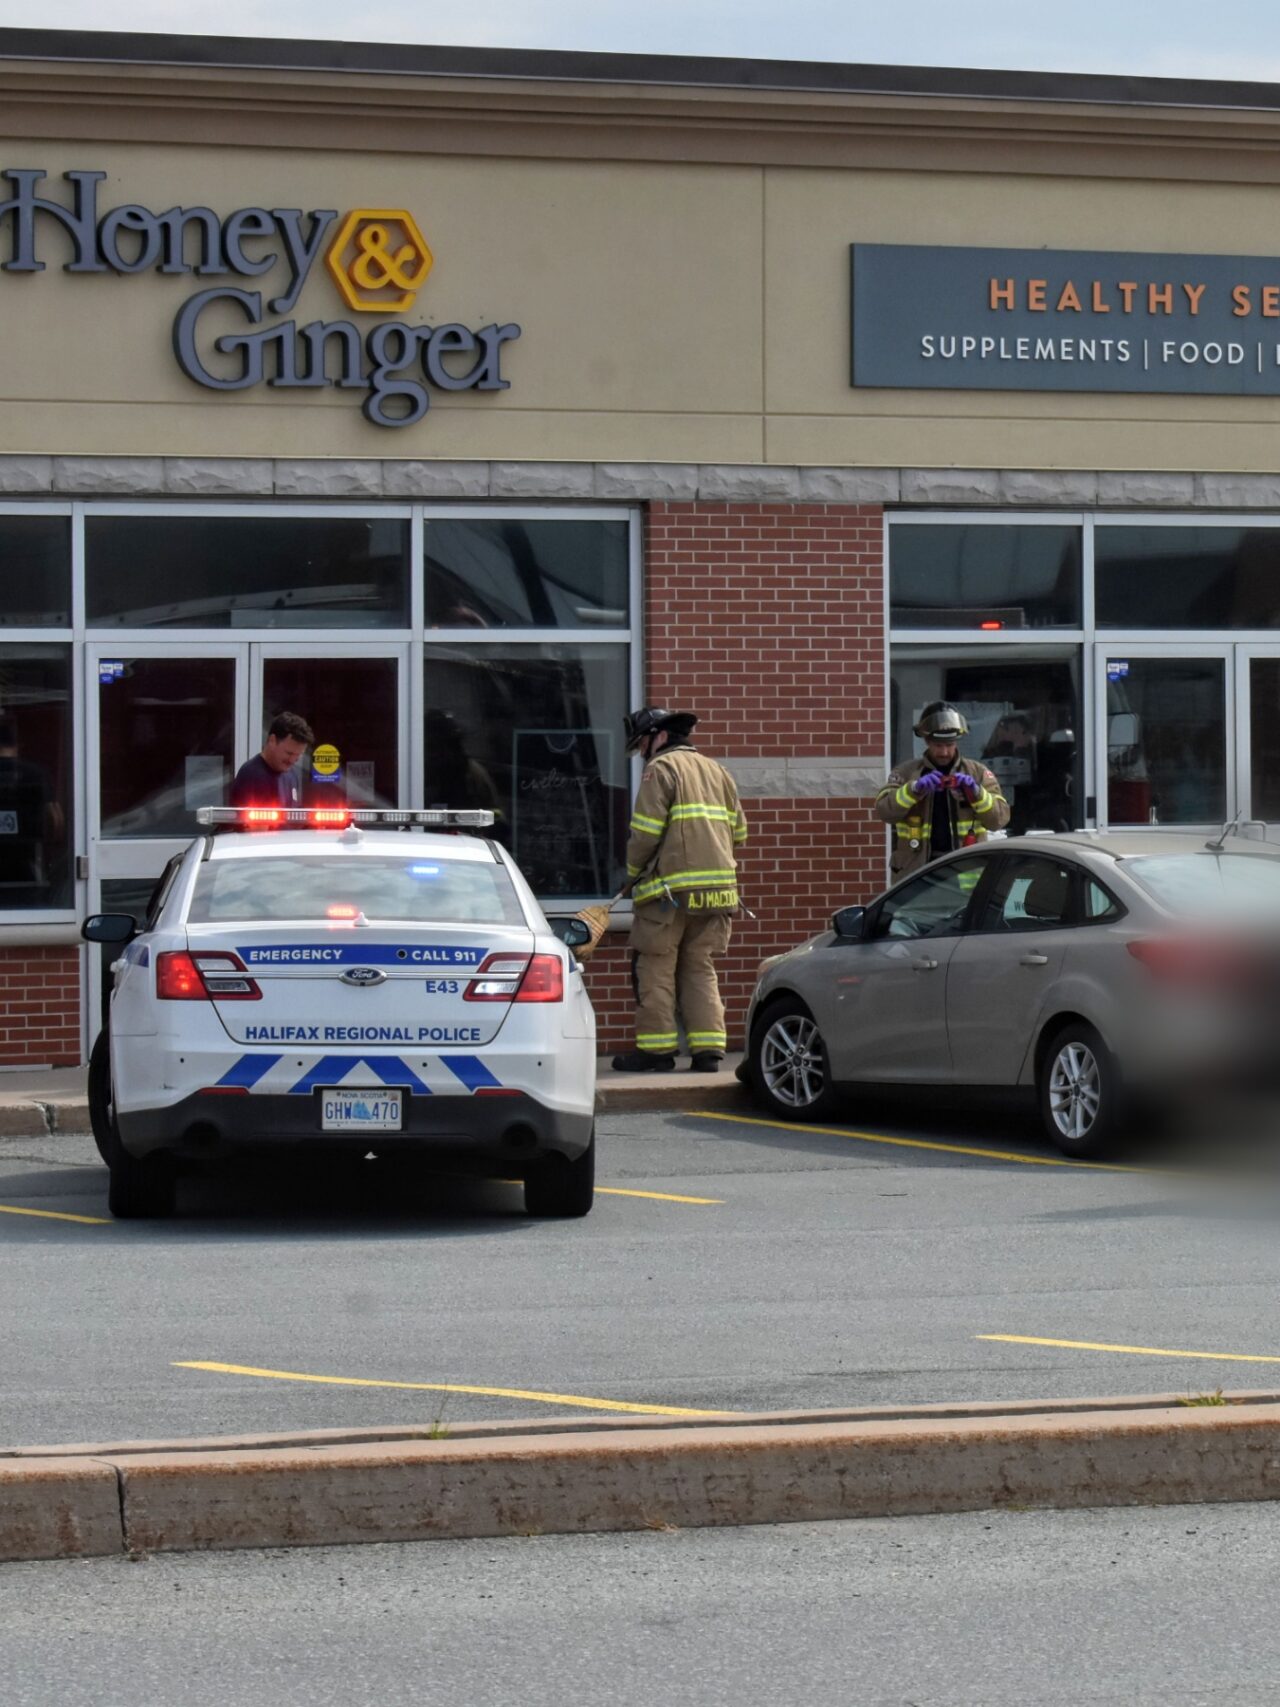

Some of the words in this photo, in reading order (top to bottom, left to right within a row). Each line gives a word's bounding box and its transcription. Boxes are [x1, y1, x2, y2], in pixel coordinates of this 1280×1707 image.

[0, 169, 338, 313] Honey
[989, 278, 1206, 315] HEALTHY
[171, 287, 521, 427] Ginger
[921, 335, 1132, 362] SUPPLEMENTS
[1162, 342, 1245, 366] FOOD
[249, 949, 343, 961] EMERGENCY
[411, 949, 450, 961] CALL
[454, 951, 477, 962] 911
[351, 968, 374, 979] Ford
[425, 981, 459, 994] E43
[245, 1026, 319, 1041] HALIFAX
[323, 1026, 413, 1042] REGIONAL
[418, 1028, 480, 1042] POLICE
[325, 1102, 352, 1120] GHW
[372, 1102, 399, 1120] 470
